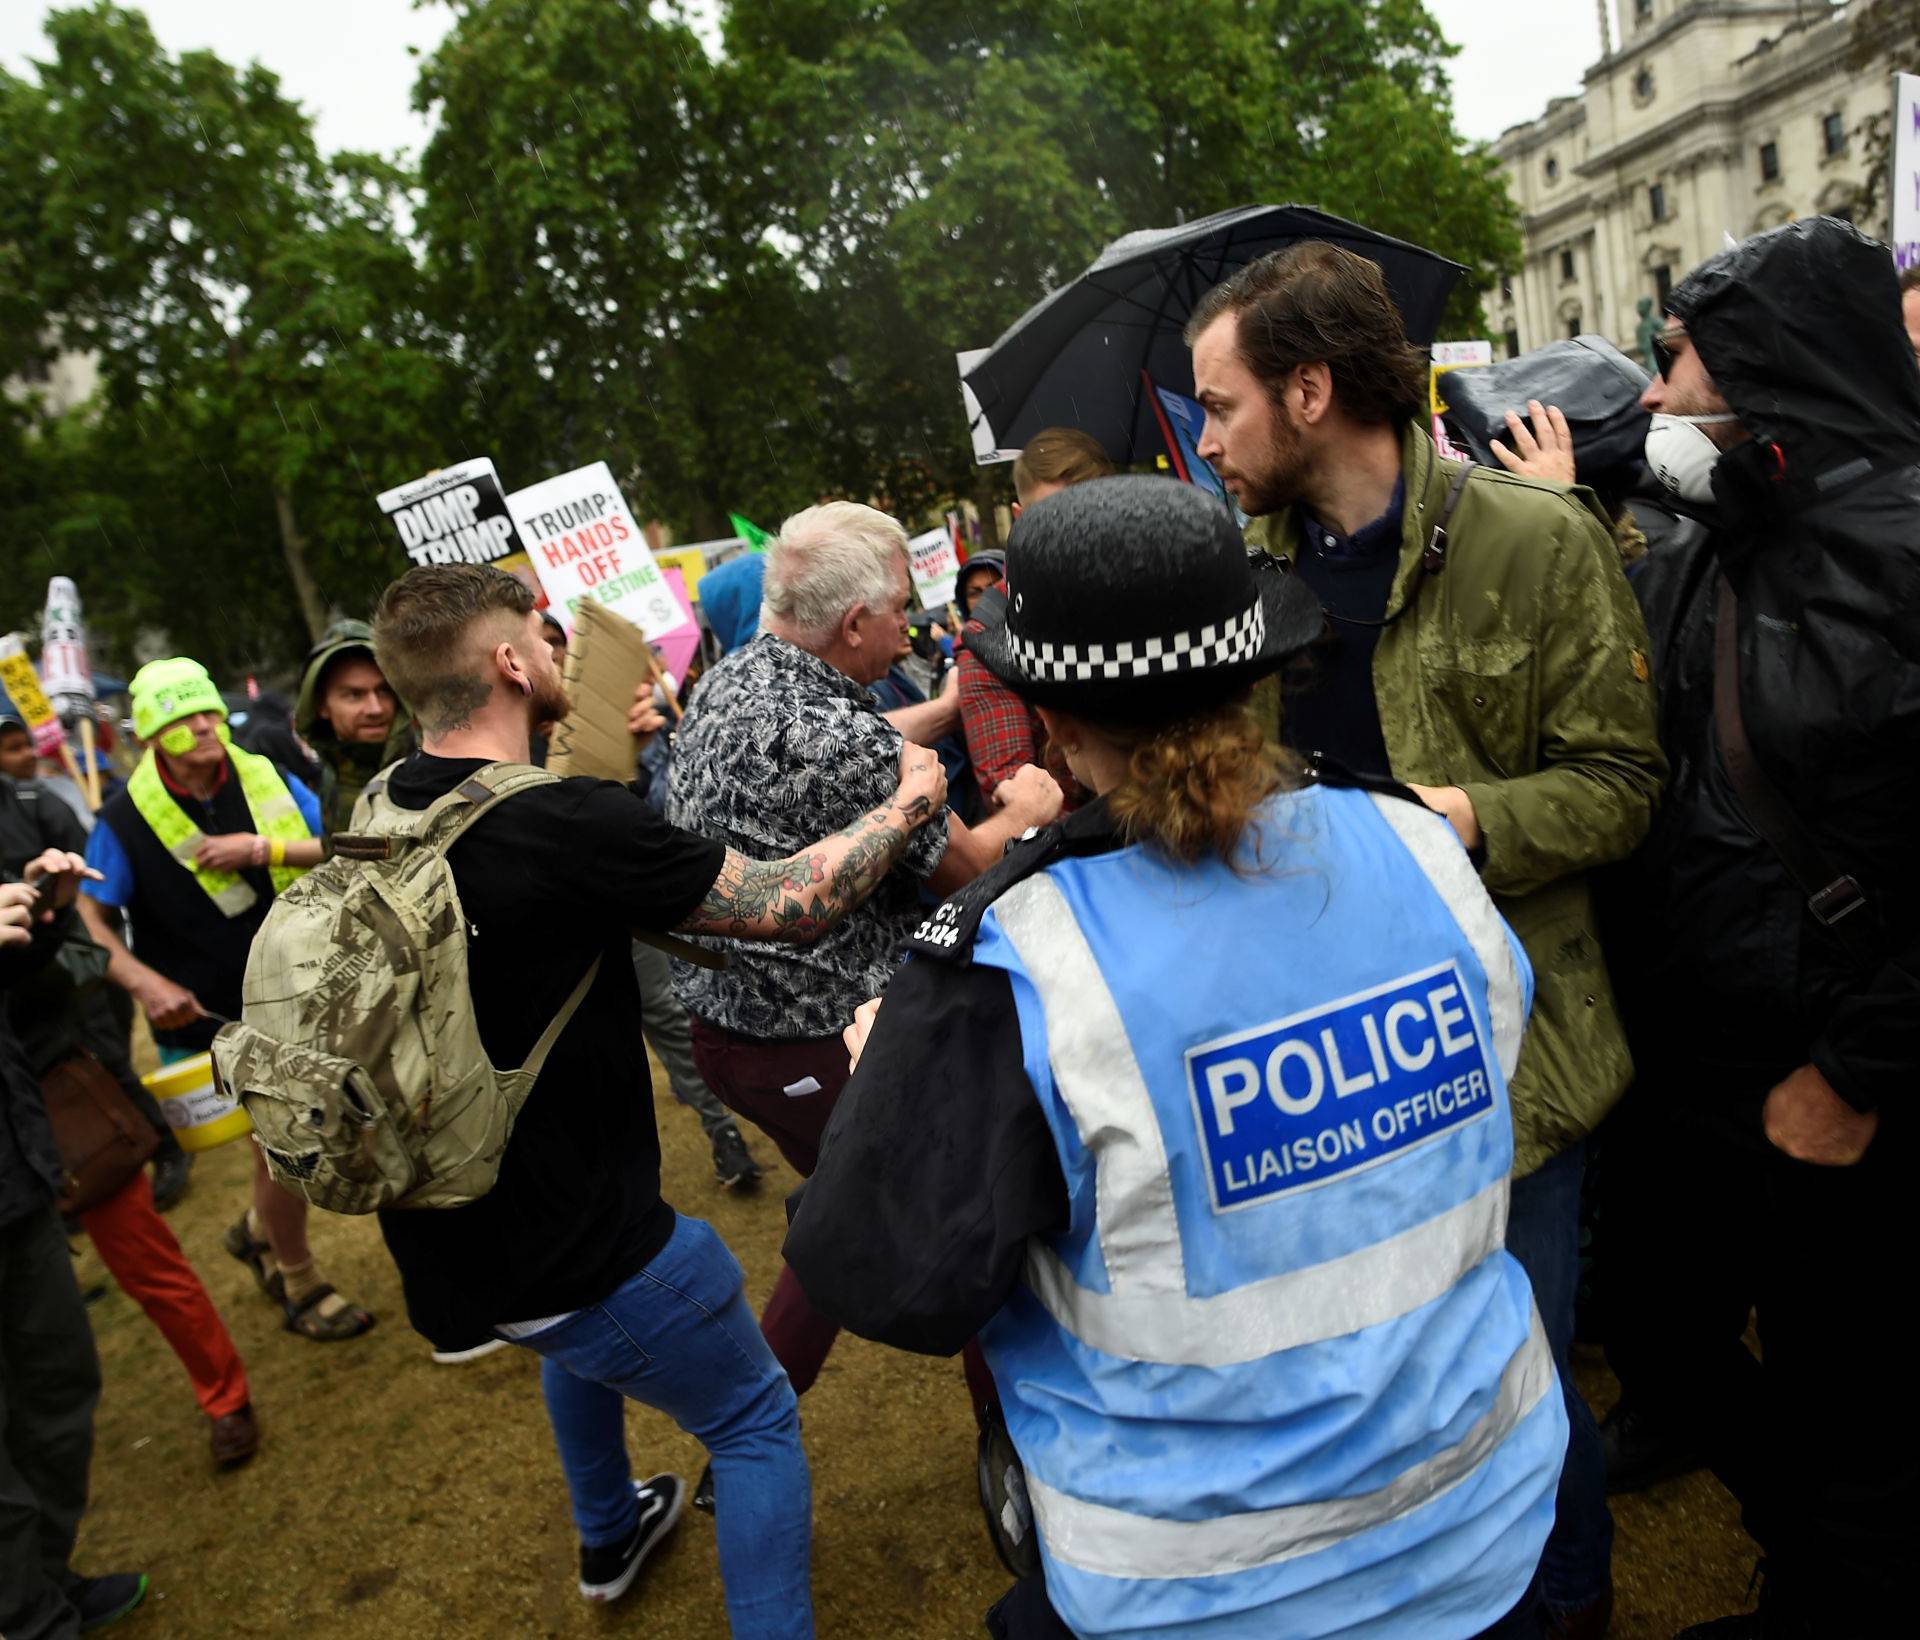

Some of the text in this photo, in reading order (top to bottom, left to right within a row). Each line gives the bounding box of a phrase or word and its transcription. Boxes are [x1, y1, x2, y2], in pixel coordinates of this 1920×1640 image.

[392, 483, 481, 551] DUMP
[407, 514, 513, 568] TRUMP
[524, 493, 619, 541] TRUMP:
[541, 515, 630, 569] HANDS
[566, 565, 658, 616] PESTINE
[577, 549, 622, 587] OFF
[1205, 982, 1476, 1137] POLICE
[1222, 1068, 1488, 1192] LIAISON OFFICER
